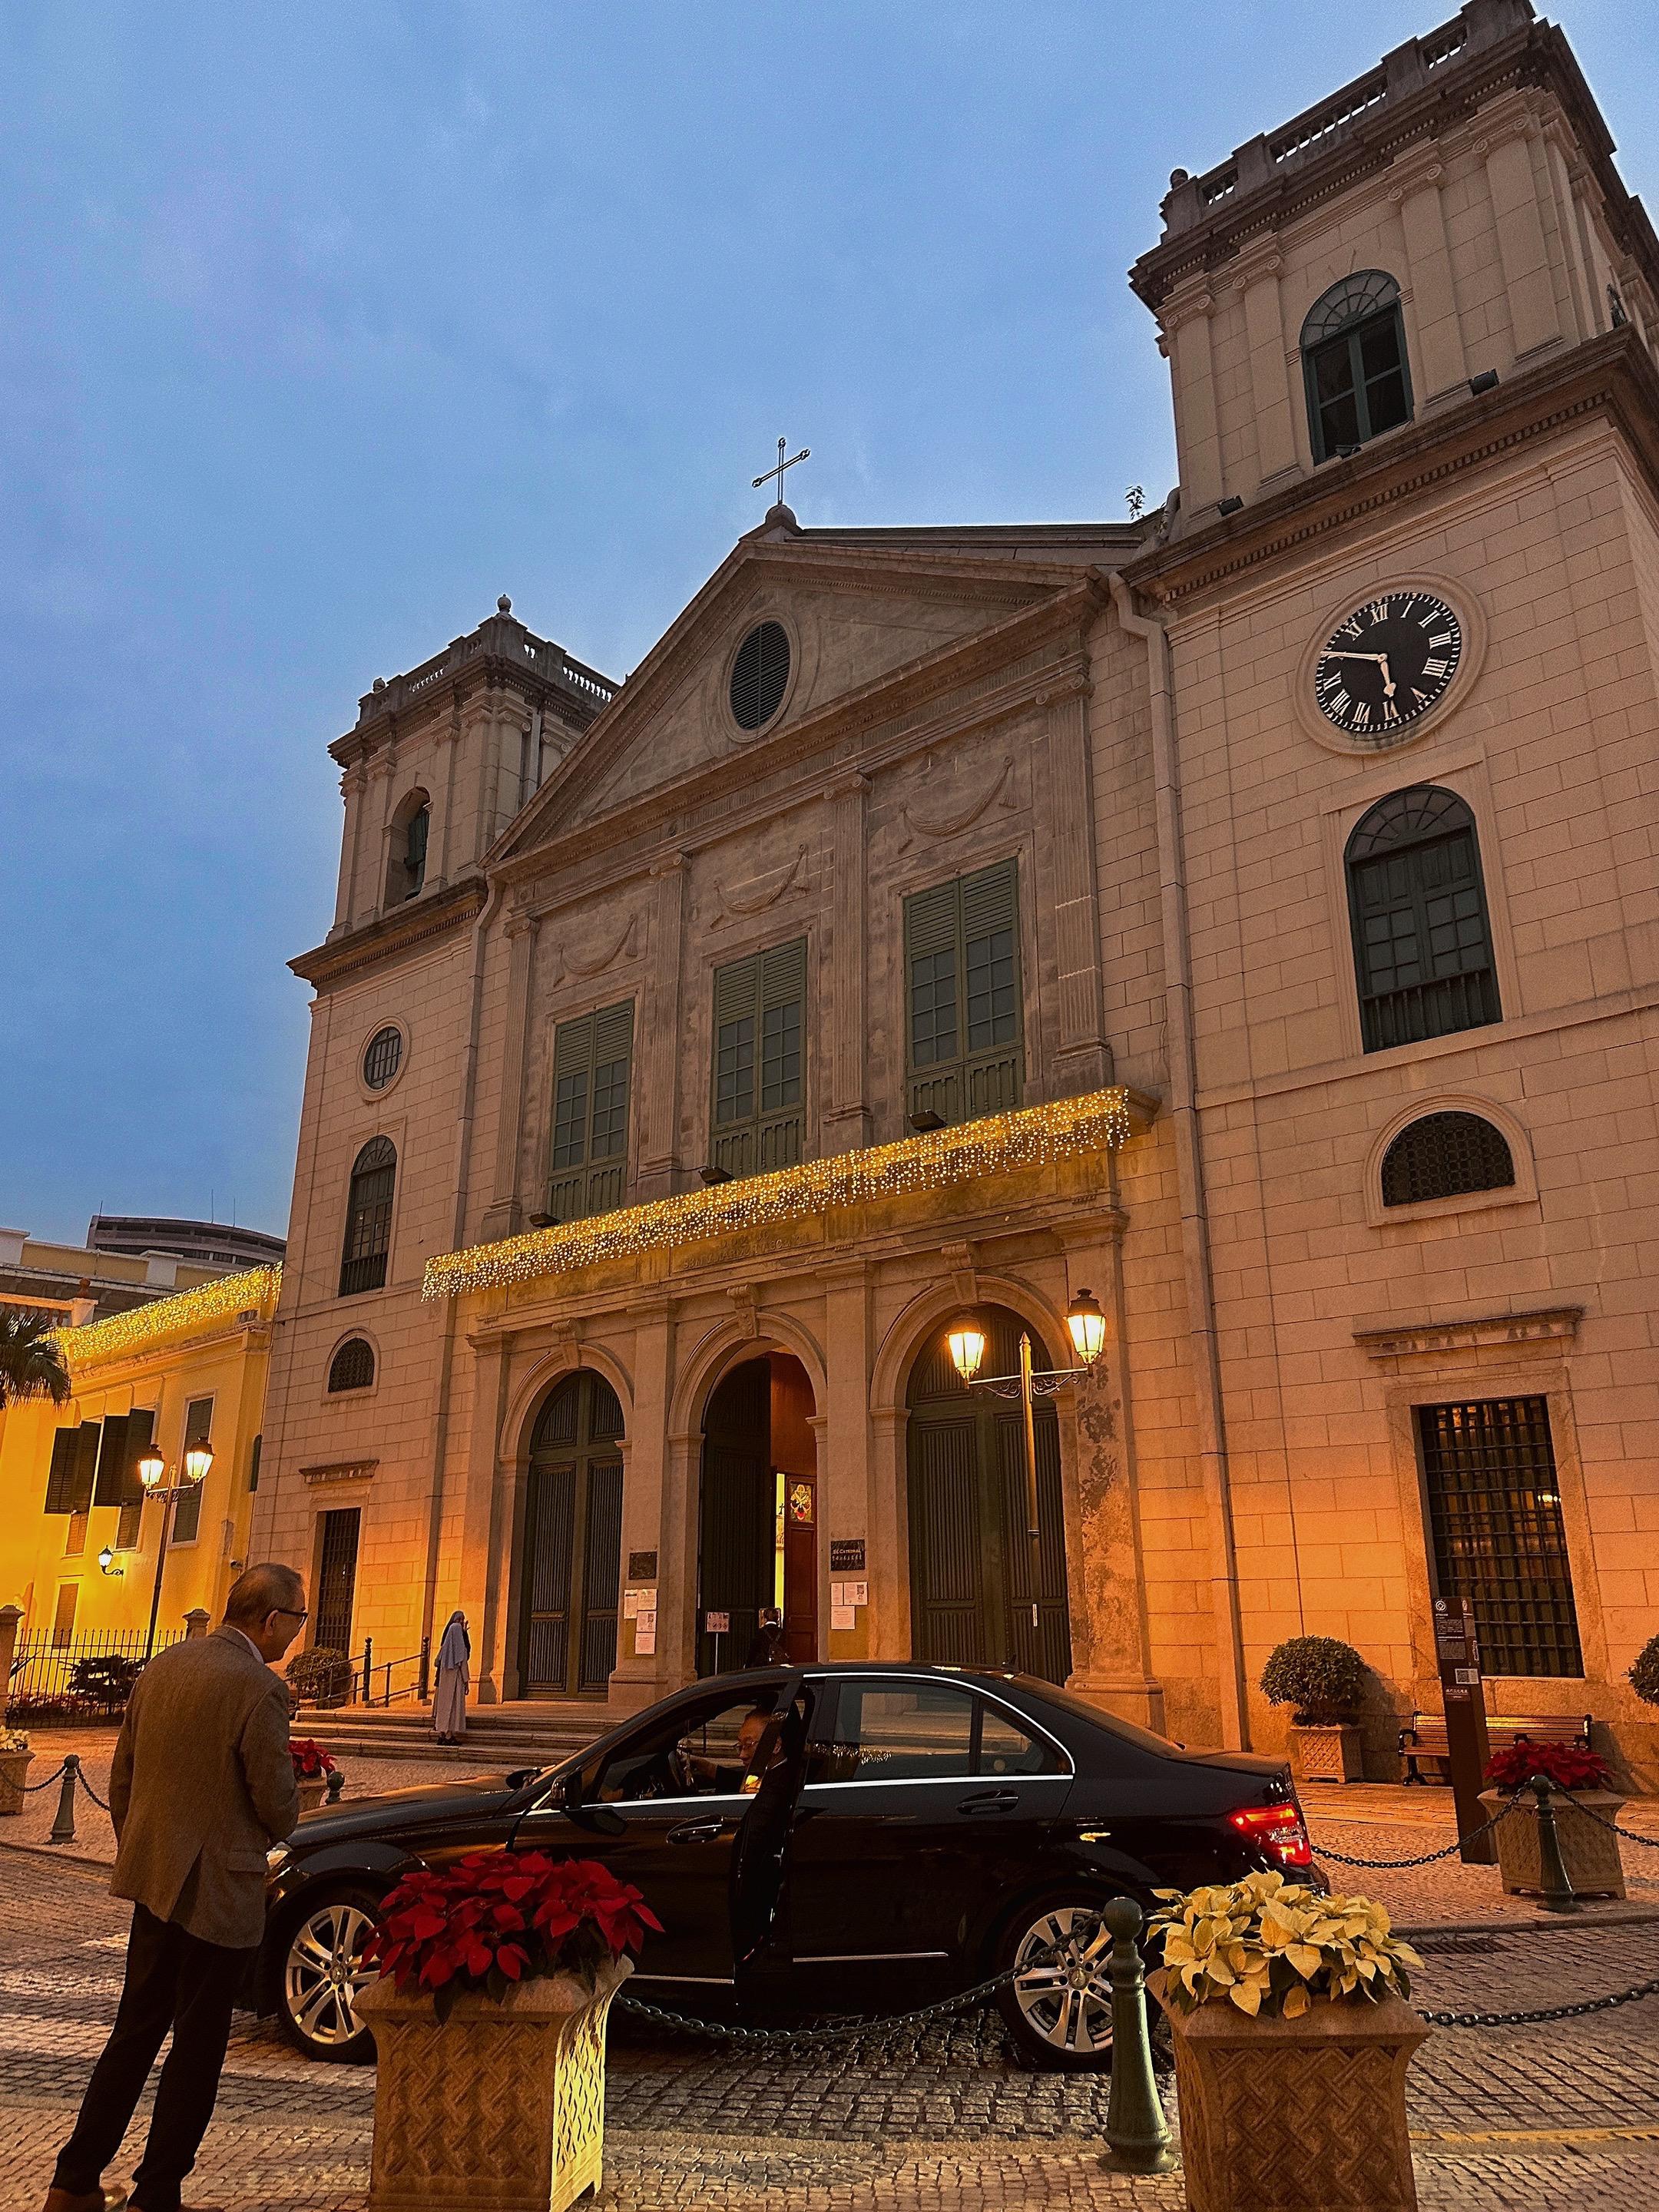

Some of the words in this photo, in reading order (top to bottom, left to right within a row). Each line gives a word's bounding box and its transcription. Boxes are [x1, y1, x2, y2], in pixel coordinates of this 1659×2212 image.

[1369, 603, 1389, 627] XII
[1400, 601, 1414, 619] I
[1418, 610, 1441, 629] II
[1345, 621, 1365, 641] XI
[1429, 632, 1452, 650] III
[1421, 657, 1449, 679] IIII
[1330, 689, 1352, 717] VIII
[1410, 687, 1428, 704] V
[1352, 701, 1372, 724] VII
[1382, 700, 1400, 721] VI
